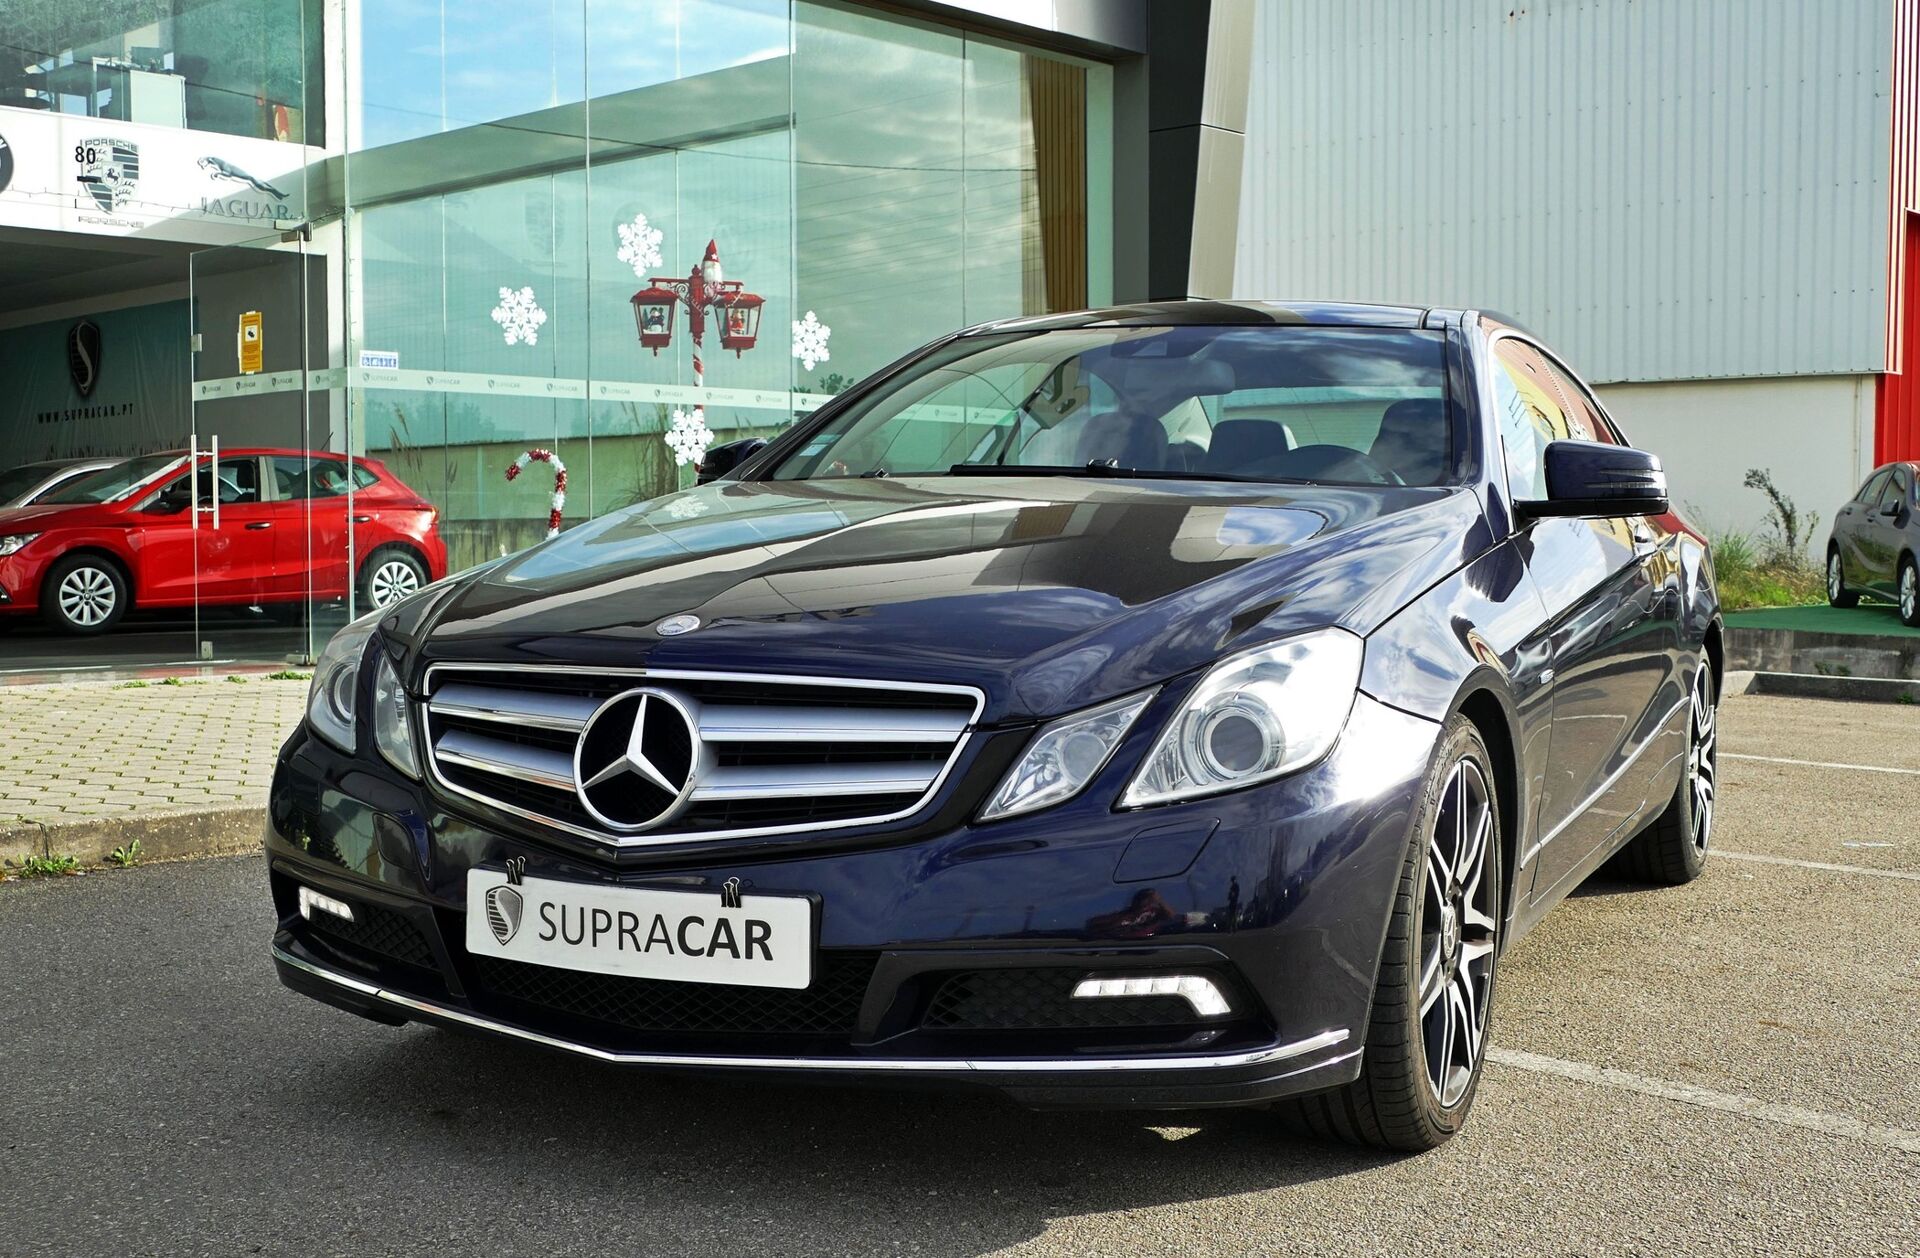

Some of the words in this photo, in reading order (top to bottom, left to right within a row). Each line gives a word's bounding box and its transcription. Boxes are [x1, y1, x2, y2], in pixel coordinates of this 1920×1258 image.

[75, 146, 96, 164] 80
[85, 138, 138, 153] PORSCHE
[201, 197, 289, 220] JAGUAR
[37, 403, 133, 424] WWW.SUPRACAR.PT
[539, 902, 774, 961] SUPRACAR
